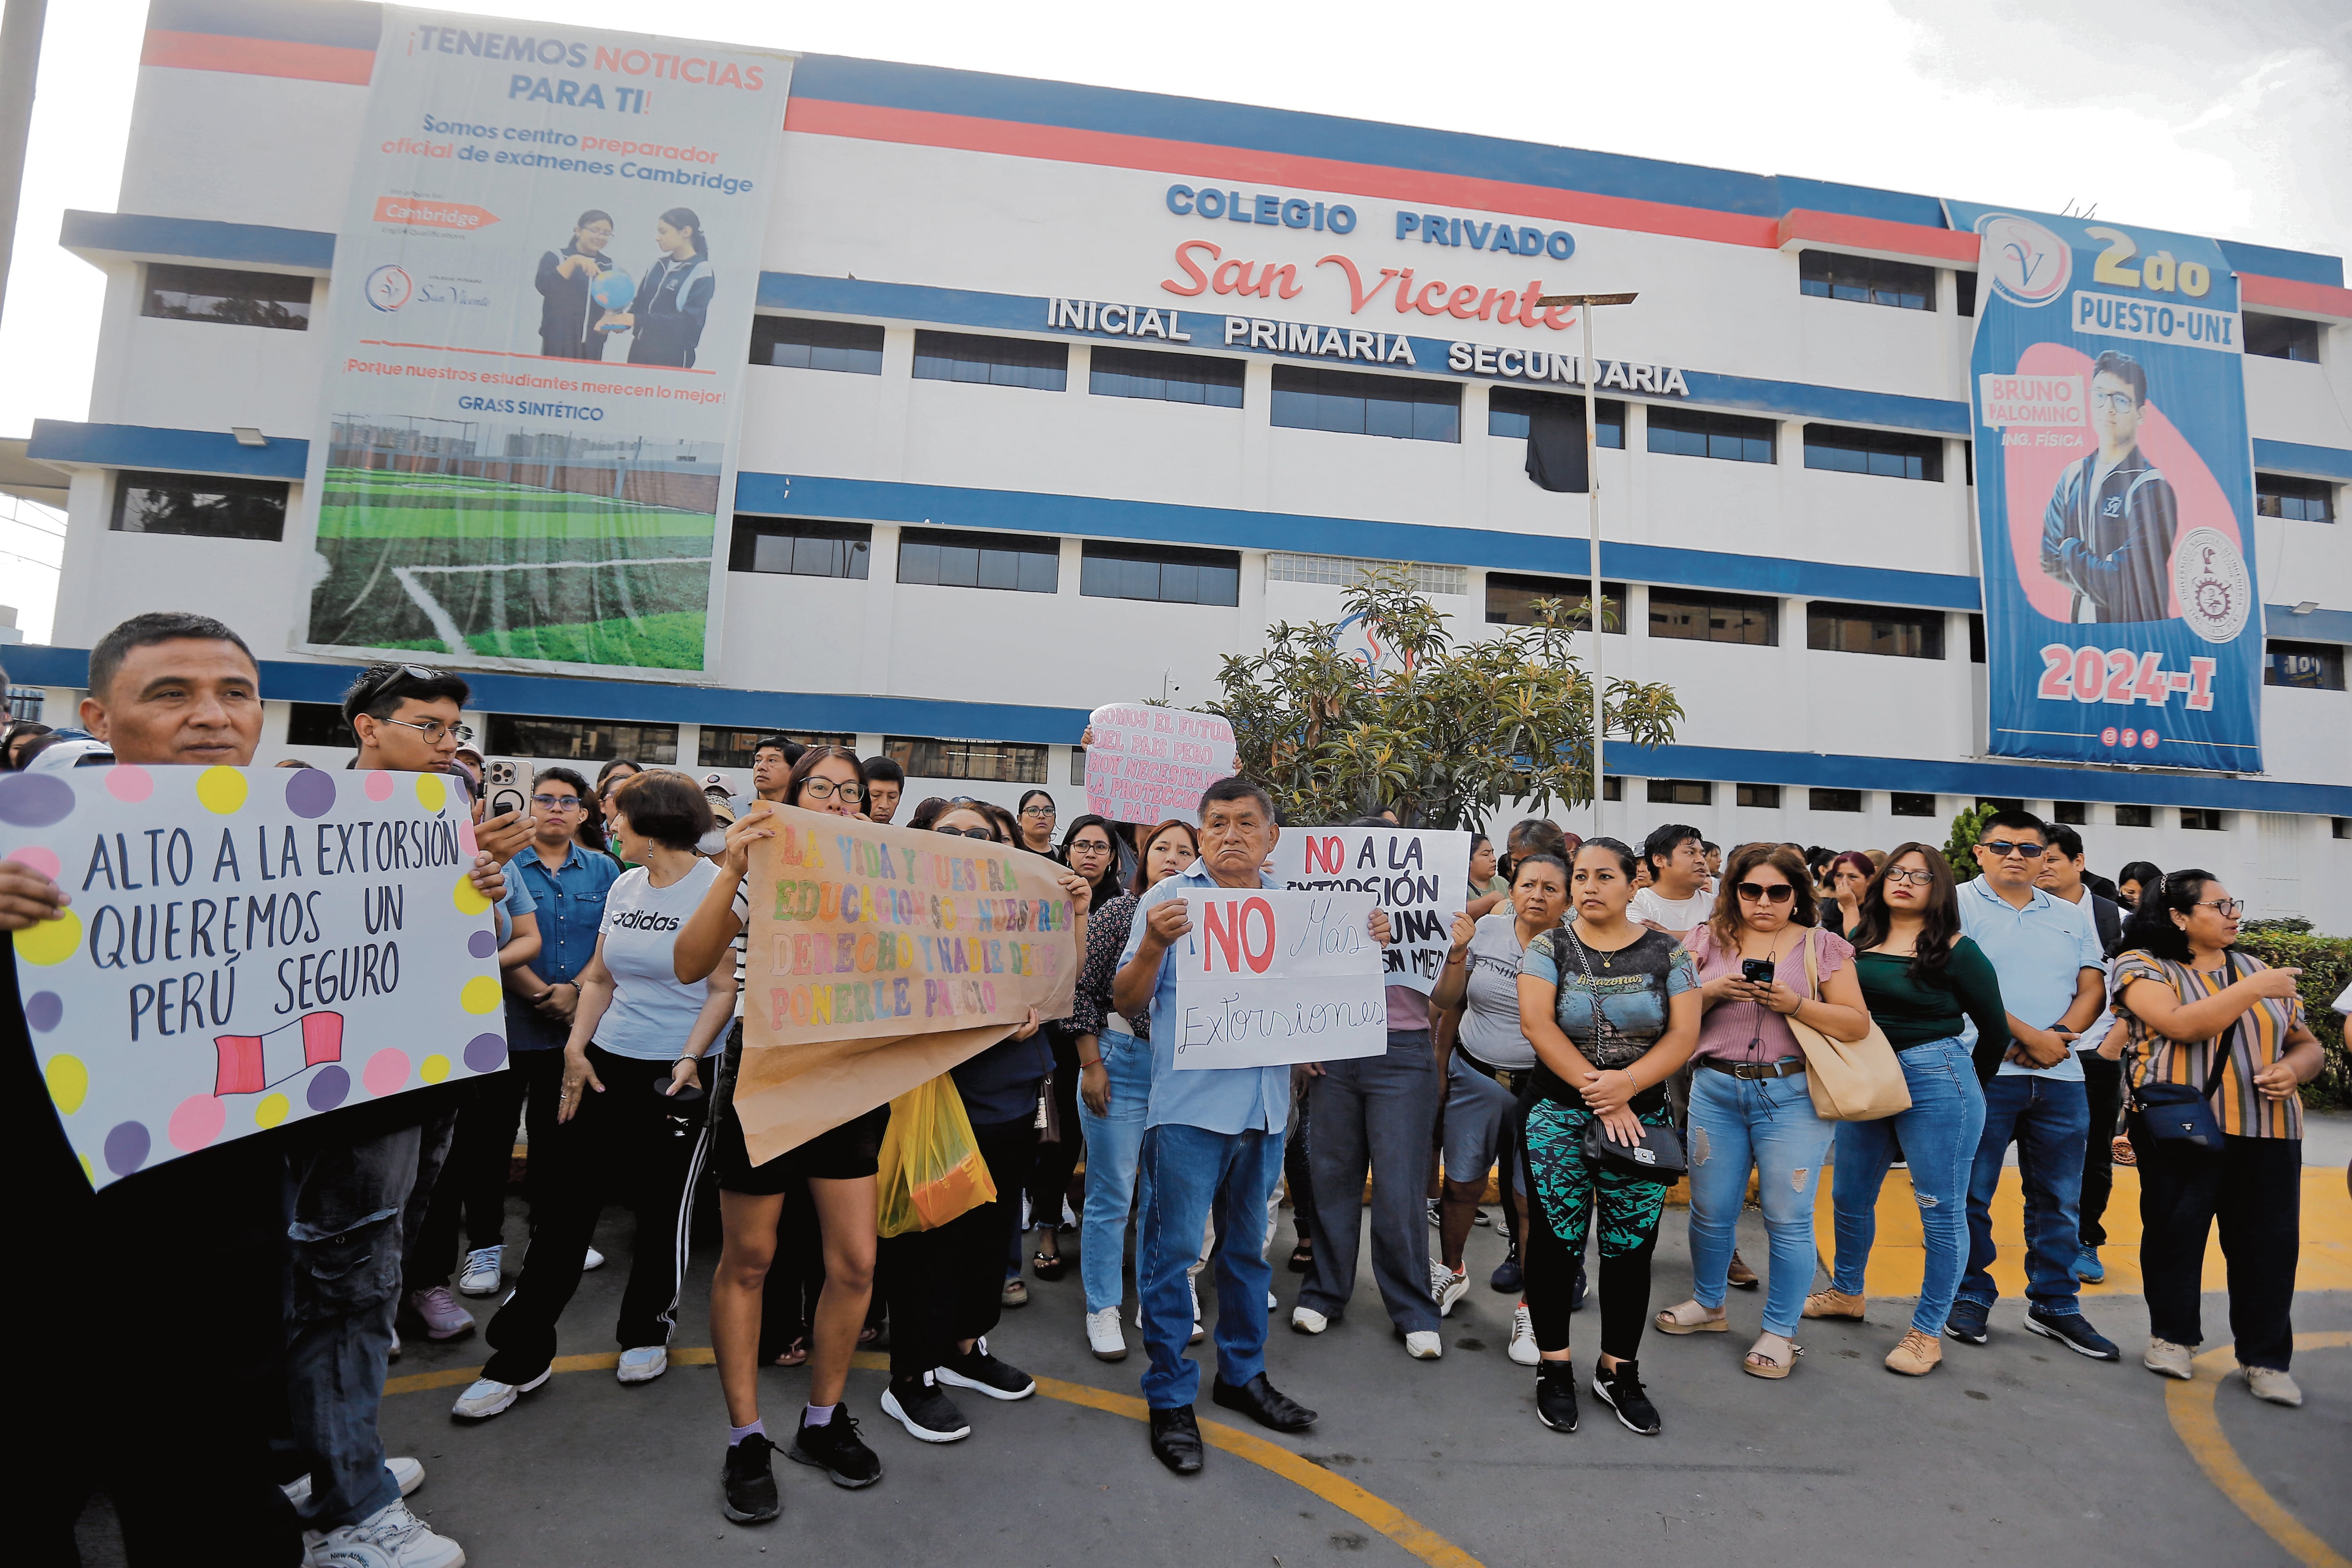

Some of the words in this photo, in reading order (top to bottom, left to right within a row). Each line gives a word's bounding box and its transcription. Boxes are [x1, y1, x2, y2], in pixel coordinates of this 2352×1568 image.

[407, 24, 587, 70] ¡TENEMOS
[594, 46, 764, 90] NOTICIAS
[509, 74, 605, 110] PARA
[616, 87, 652, 115] TI!
[423, 114, 498, 140] Somos
[504, 126, 577, 146] centro
[581, 135, 718, 164] preparador
[381, 138, 453, 159] oficial
[457, 145, 488, 163] de
[495, 149, 614, 177] exámenes
[620, 162, 753, 194] Cambridge
[386, 204, 478, 227] Cambridge
[1165, 183, 1358, 235] COLEGIO
[1396, 209, 1577, 261] PRIVADO
[1160, 239, 1303, 299] San
[1316, 254, 1578, 331] Vicente
[2084, 226, 2210, 297] 2do
[2081, 297, 2232, 345] PUESTO-UNI
[1047, 297, 1191, 342] INICIAL
[1224, 316, 1416, 365] PRIMARIA
[1448, 341, 1690, 396] SECUNDARIA
[342, 358, 402, 376] ¡Porque
[406, 365, 477, 383] nuestros
[480, 371, 578, 392] estudiantes
[581, 382, 653, 398] merecen
[657, 385, 671, 399] lo
[674, 389, 726, 405] mejor!
[1993, 379, 2072, 402] BRUNO
[458, 396, 515, 414] GRASS
[518, 400, 604, 422] SINTÉTICO
[1989, 403, 2080, 422] PALOMINO
[2002, 432, 2032, 446] ING.
[2035, 430, 2084, 448] FÍSICA
[2038, 644, 2216, 711] 2024-I
[1094, 708, 1149, 728] SOMOS
[1154, 712, 1174, 734] EL
[1093, 728, 1124, 751] DEL
[1131, 734, 1168, 758] PAIS
[1173, 742, 1213, 765] PERO
[1086, 773, 1105, 795] LA
[1088, 752, 1123, 774] HOY
[1124, 757, 1235, 790] NECESITAM
[1086, 793, 1114, 819] DEL
[1121, 801, 1160, 825] PAIS
[82, 828, 193, 891] ALTO
[213, 828, 240, 883] A
[259, 824, 302, 881] LA
[317, 808, 459, 876] EXTORSIÓN
[781, 824, 824, 868] LA
[835, 835, 896, 879] VIDA
[901, 848, 915, 884] Y
[922, 851, 1018, 892] NUESTRA
[1305, 835, 1344, 875] NO
[1357, 836, 1376, 869] A
[1388, 836, 1423, 870] LA
[89, 891, 322, 969] QUEREMOS
[364, 884, 403, 935] UN
[612, 910, 680, 931] adidas
[773, 879, 928, 926] EDUCACION
[930, 895, 974, 932] SON
[977, 898, 1073, 932] NUESTROS
[1290, 898, 1369, 957] Más
[771, 931, 914, 977] DERECHO
[918, 935, 934, 972] Y
[938, 936, 1004, 974] NADIE
[1010, 940, 1058, 977] DEBE
[1382, 949, 1406, 974] SIN
[1411, 948, 1447, 980] MIED
[129, 952, 241, 1042] PERÚ
[275, 941, 399, 1014] SEGURO
[770, 977, 912, 1031] PONERLE
[924, 979, 996, 1018] PRECIO
[1178, 992, 1386, 1055] Extorsiones
